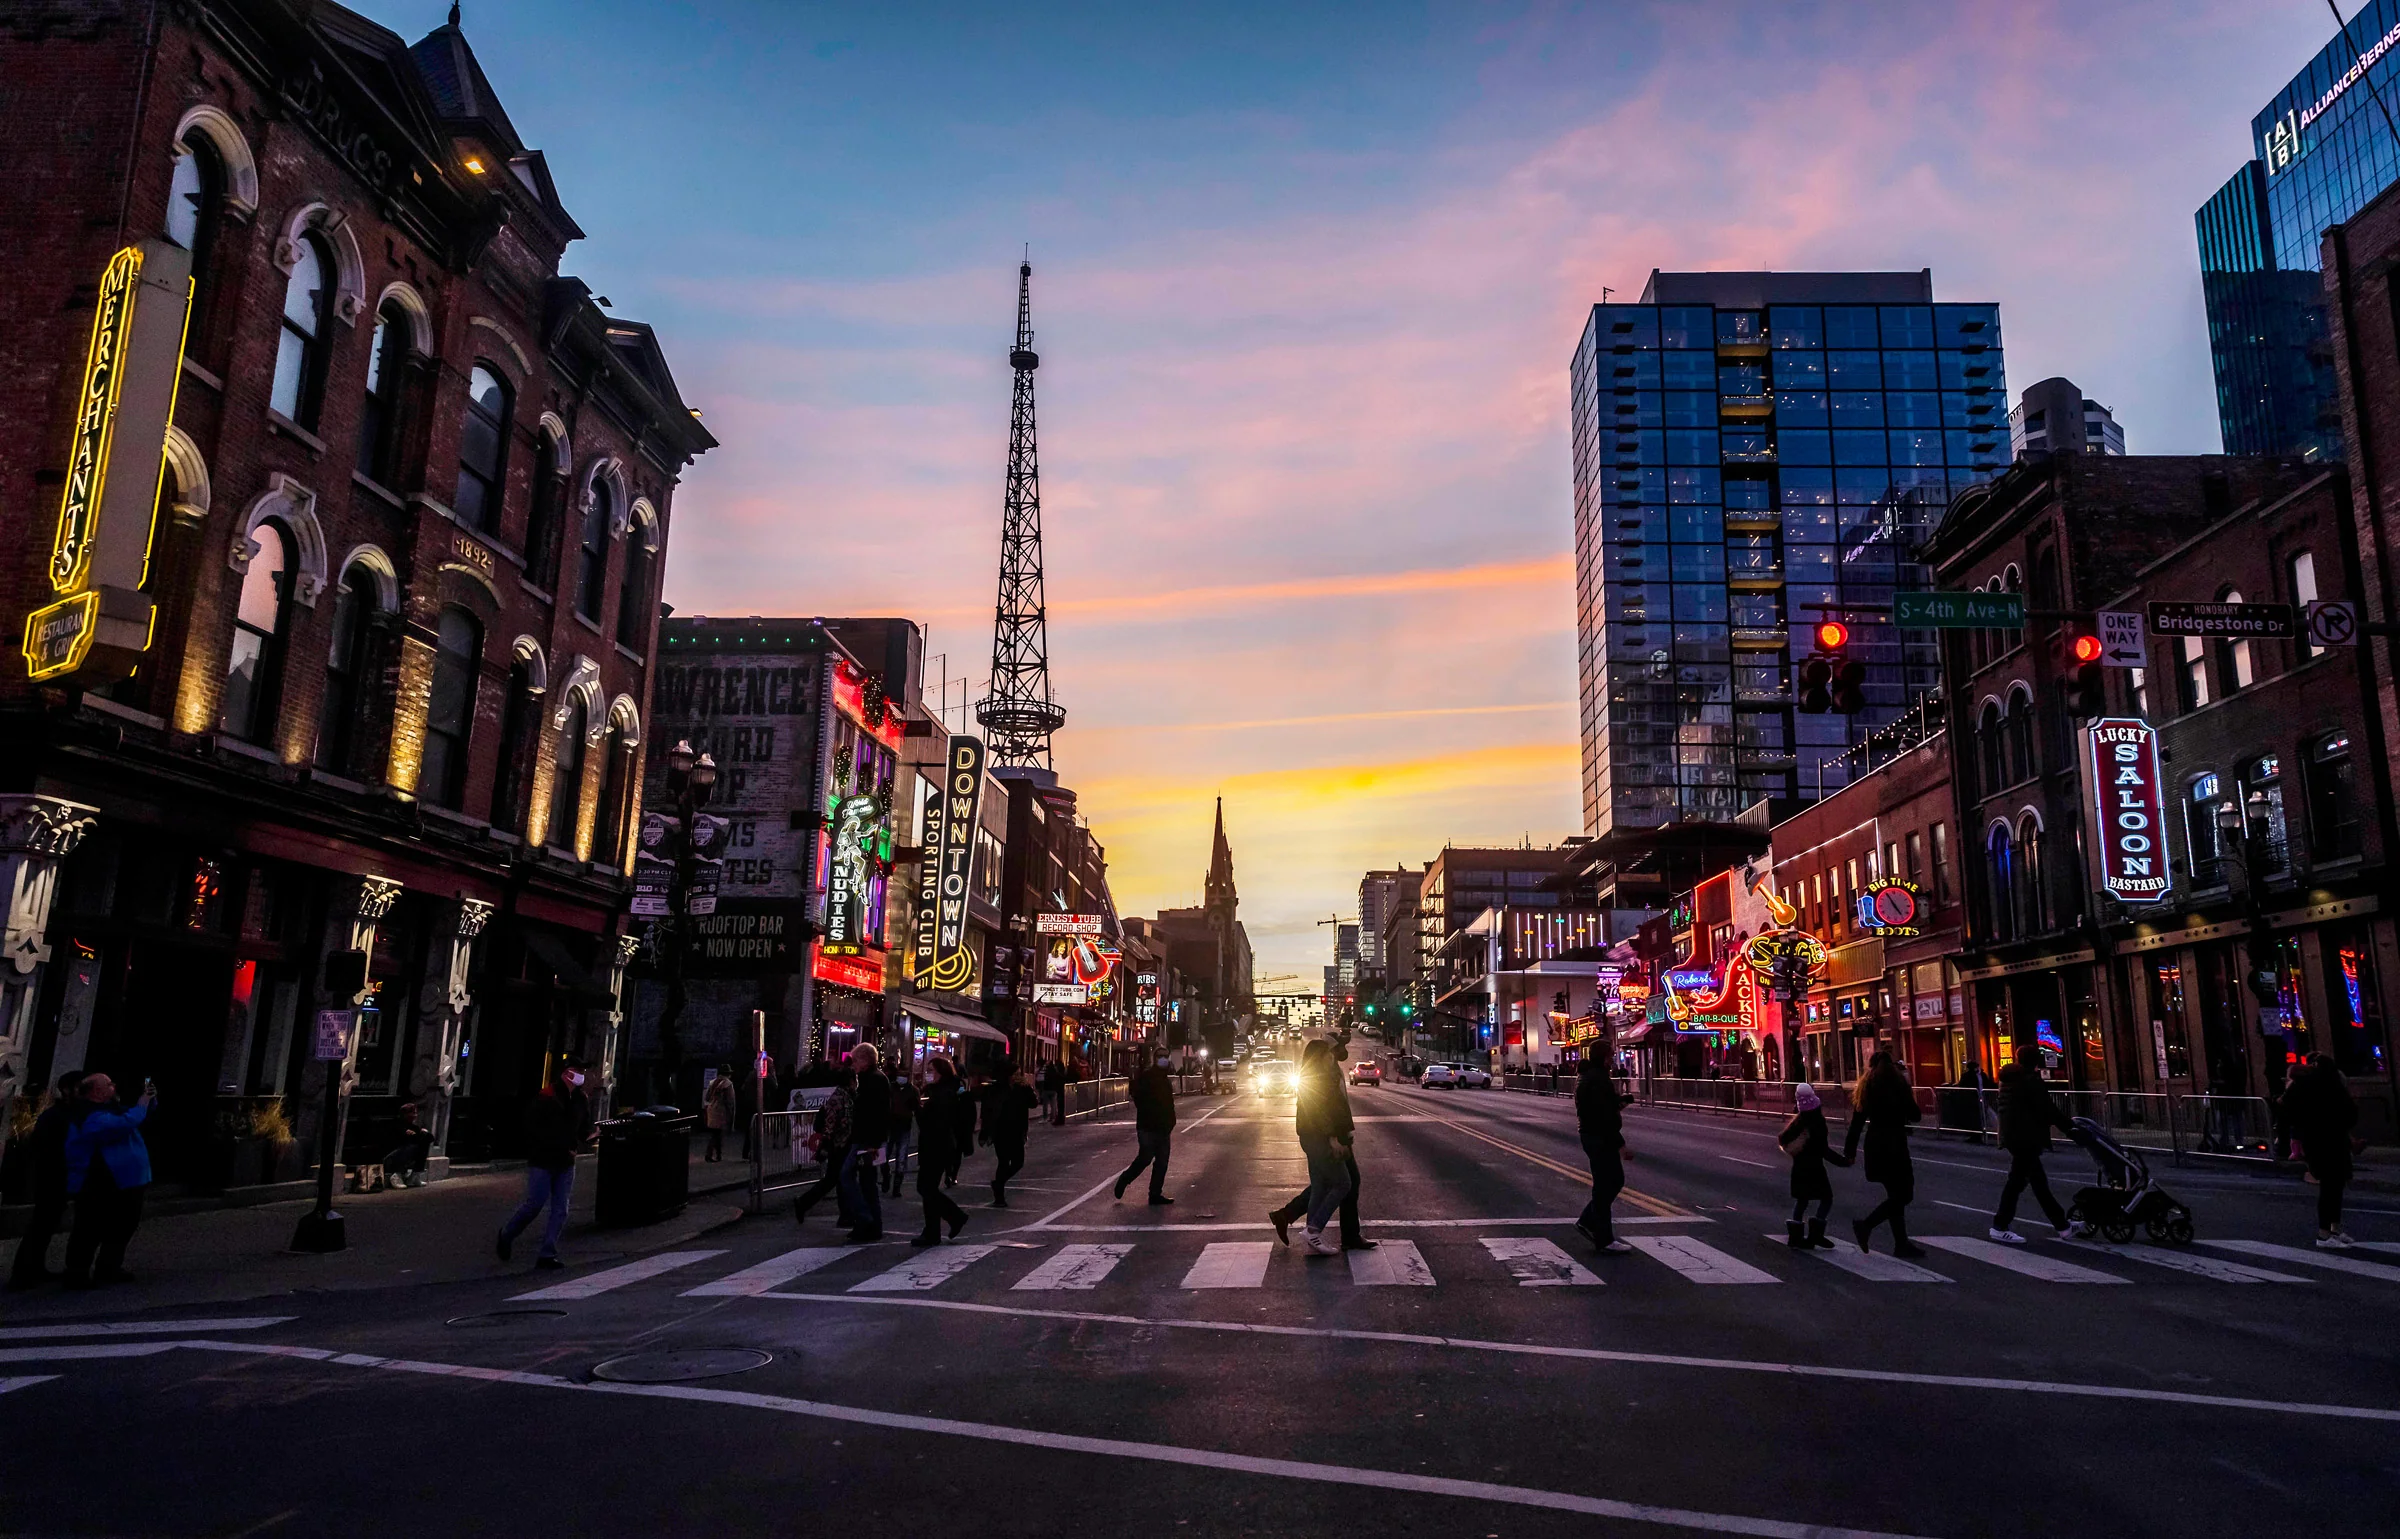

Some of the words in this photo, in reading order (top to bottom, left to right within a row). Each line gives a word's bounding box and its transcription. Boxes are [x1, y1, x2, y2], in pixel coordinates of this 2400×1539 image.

[59, 259, 127, 576] MERCHANTS
[2194, 605, 2239, 615] HONORARY
[37, 612, 84, 643] RESTAURAN
[2105, 615, 2137, 629] ONE
[2158, 615, 2264, 633] Bridgestone
[2268, 620, 2285, 632] Dr
[2105, 632, 2139, 645] WAY
[2096, 727, 2149, 743] LUCKY
[2114, 743, 2152, 876] SALOON
[922, 808, 941, 900] SPORTING
[942, 747, 975, 947] DOWNTOWN
[1869, 878, 1888, 892] BIG
[1890, 877, 1919, 893] TIME
[2109, 876, 2166, 892] BASTARD
[830, 865, 849, 940] NUDIES
[759, 915, 784, 935] BAR
[1038, 913, 1074, 923] ERNEST
[1077, 914, 1102, 923] TUBB
[918, 909, 935, 956] CLUB
[1042, 923, 1074, 932] RECORD
[1076, 924, 1097, 933] SHOP
[1876, 926, 1920, 936] BOOTS
[706, 938, 736, 958] NOW
[739, 938, 773, 959] OPEN
[1751, 936, 1828, 968] STGE
[916, 976, 929, 989] 411
[1137, 974, 1156, 984] RIBS
[1760, 976, 1771, 986] ON
[1735, 957, 1755, 1027] JACKS
[1693, 1014, 1739, 1023] BAR-B-QUE
